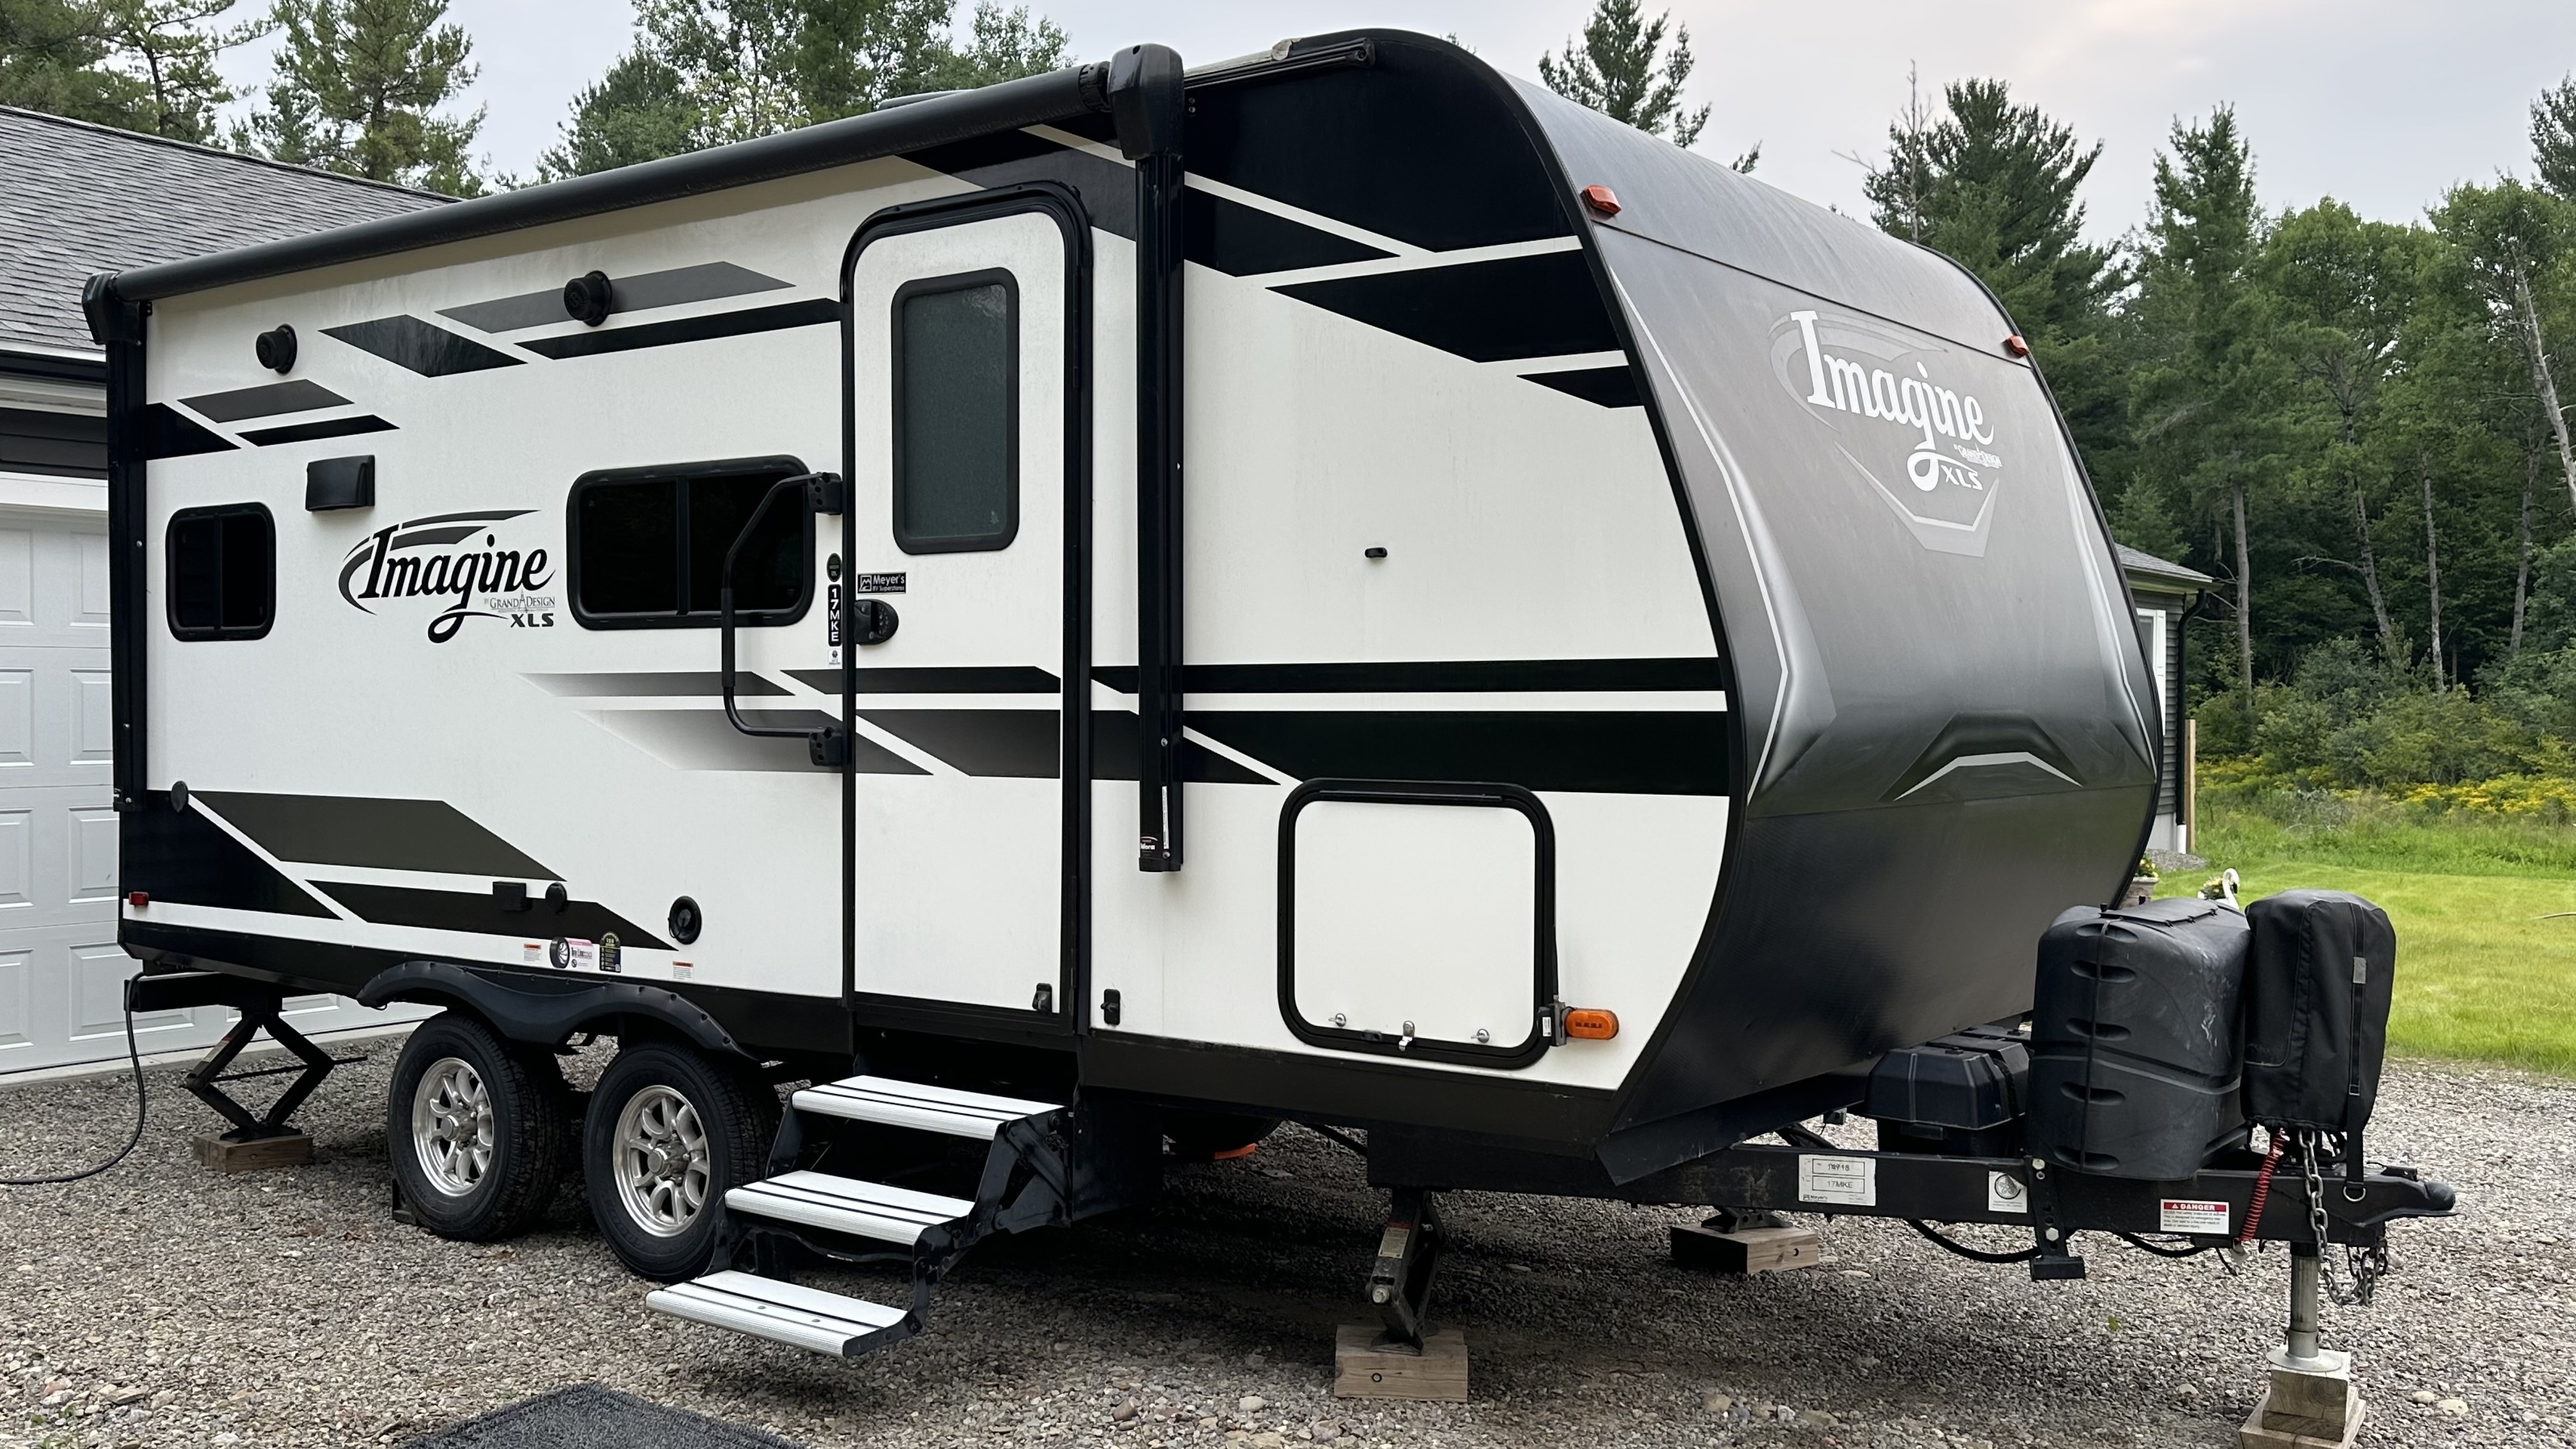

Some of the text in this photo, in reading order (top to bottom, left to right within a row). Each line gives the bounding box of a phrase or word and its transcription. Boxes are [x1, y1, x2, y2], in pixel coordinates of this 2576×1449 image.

[1790, 310, 1994, 491] Imagine
[1940, 464, 1982, 491] XLS
[358, 524, 556, 643] Imagine
[873, 575, 905, 586] Meyer's
[490, 597, 519, 608] GRAND
[526, 596, 555, 607] DESIGN
[830, 588, 840, 642] 17MKE
[510, 613, 554, 627] XLS
